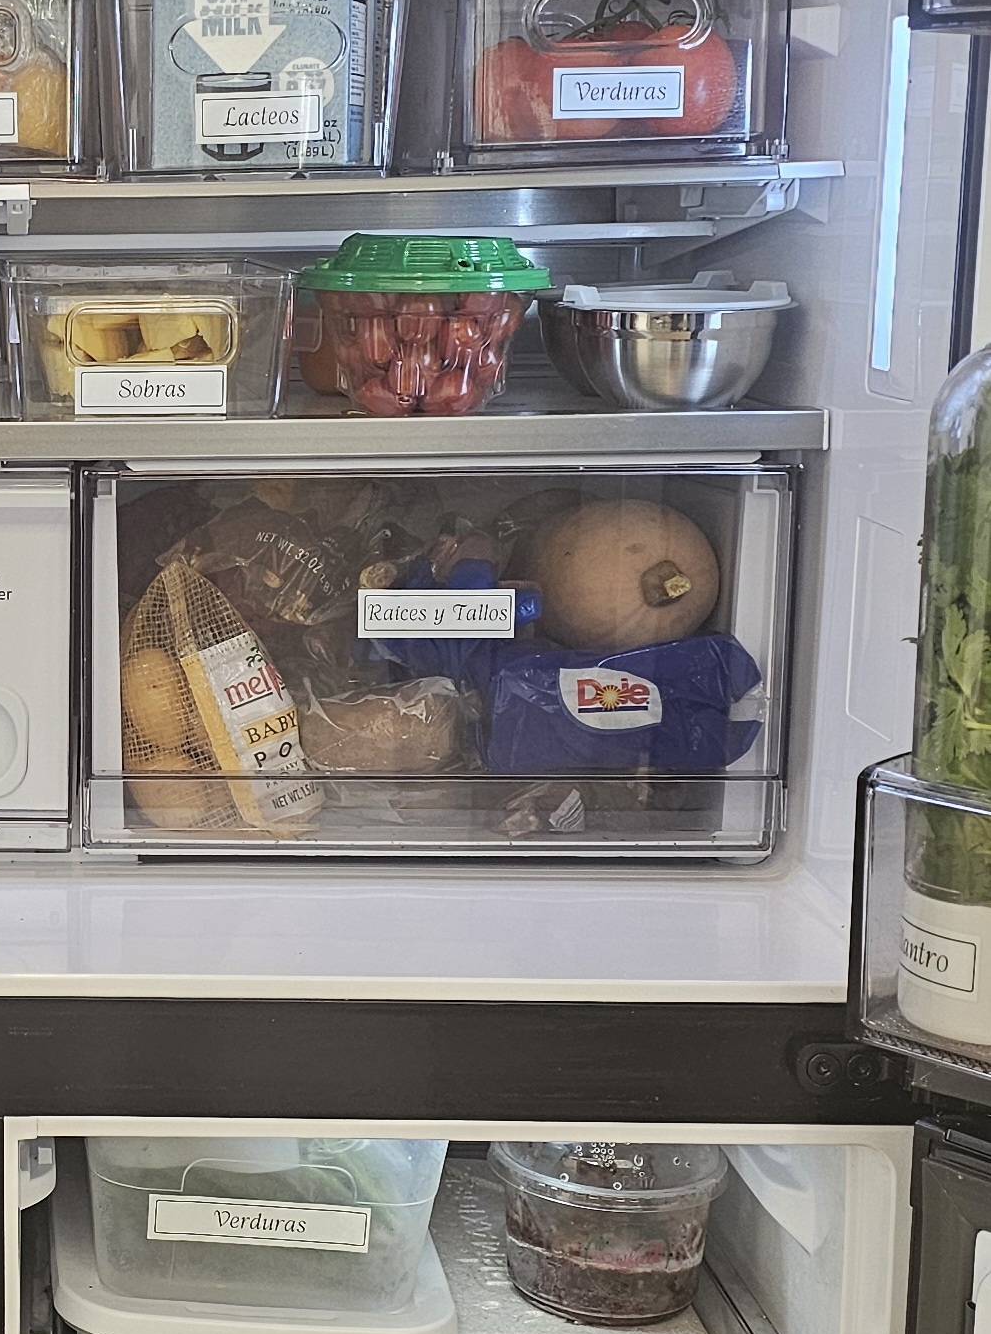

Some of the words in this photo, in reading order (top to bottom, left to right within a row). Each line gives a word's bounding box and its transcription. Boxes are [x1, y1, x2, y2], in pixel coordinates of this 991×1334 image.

[574, 81, 667, 101] Verduras
[222, 106, 300, 127] Lacteos
[118, 378, 186, 399] Sobras
[255, 531, 277, 543] NET
[277, 536, 294, 556] WT.
[294, 548, 310, 564] 32
[308, 557, 324, 574] OZ
[434, 608, 445, 626] y
[452, 603, 508, 622] Tallos
[244, 710, 298, 745] BABY
[214, 1209, 307, 1234] Verduras
